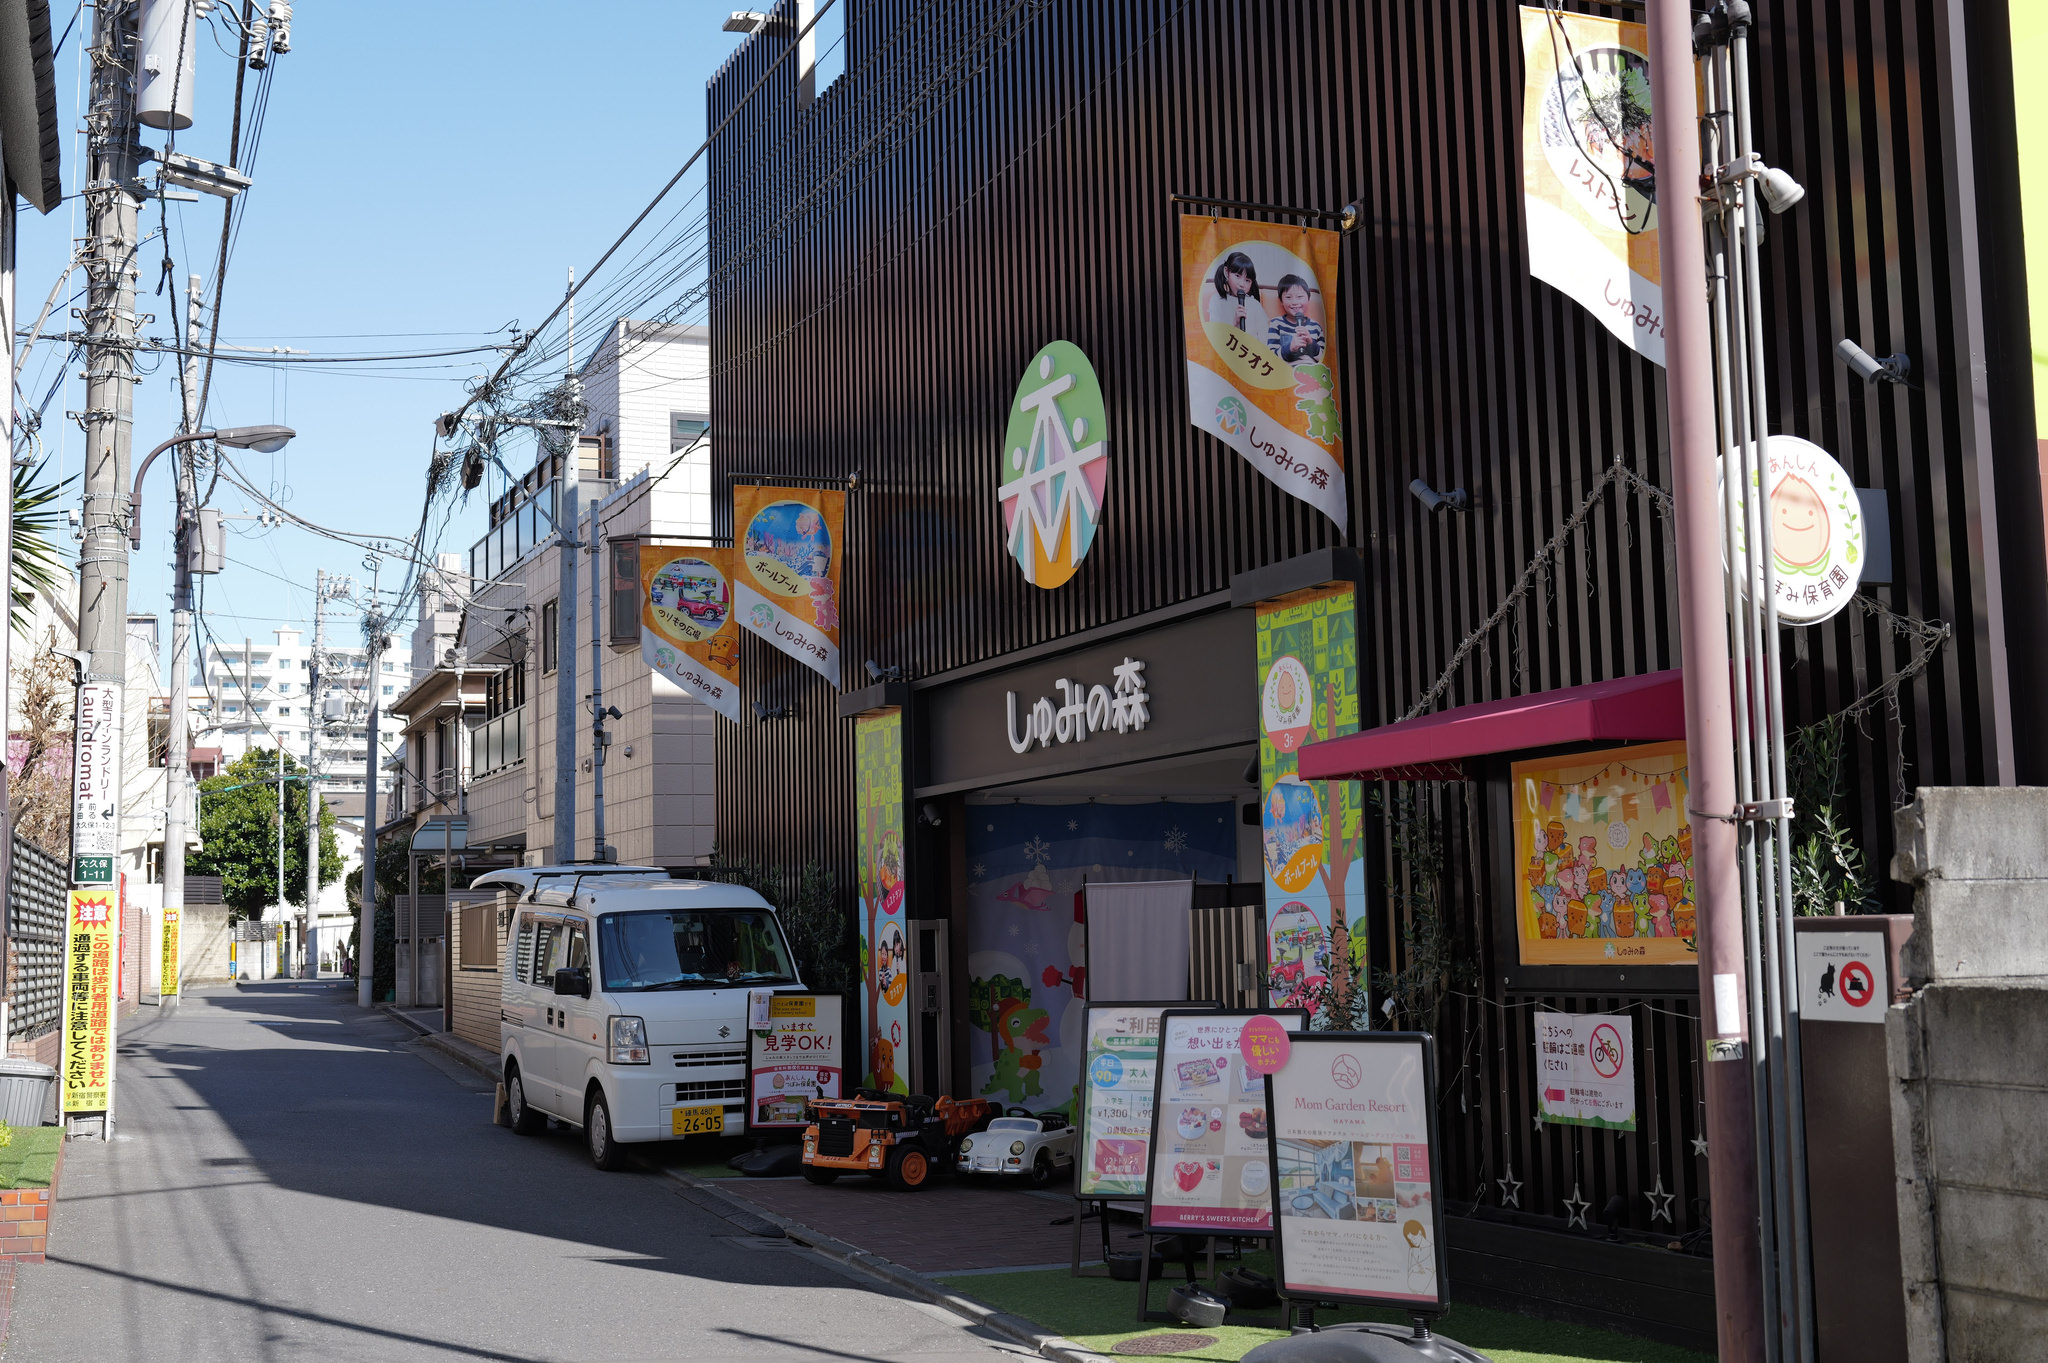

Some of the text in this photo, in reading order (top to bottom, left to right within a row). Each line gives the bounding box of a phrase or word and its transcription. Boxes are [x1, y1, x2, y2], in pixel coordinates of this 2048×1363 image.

[1226, 333, 1275, 378] カラオケ
[1250, 426, 1330, 490] しゅみの森
[1768, 454, 1819, 478] あんしん
[755, 561, 799, 595] ボールプール
[658, 608, 702, 641] のりもの広場
[774, 620, 829, 663] しゅみの森
[675, 662, 724, 701] しゅみの森
[1006, 656, 1151, 754] しゅみの森
[79, 686, 98, 801] Laundromat
[1283, 732, 1294, 749] 3F
[79, 859, 108, 868] 大久保
[1284, 854, 1318, 886] ボールプール
[82, 870, 105, 879] 1-11
[80, 904, 108, 922] 注意
[68, 933, 91, 1089] 通過する車両等に注意してください
[88, 933, 110, 1088] この道路は歩行者用道路ではありません
[781, 1022, 813, 1032] いますぐ
[1542, 1026, 1573, 1038] こちらへの
[763, 1034, 832, 1052] 見学OK!
[1248, 1034, 1280, 1045] ママにも
[1542, 1041, 1585, 1056] 駐輪はご遠慮
[1251, 1044, 1280, 1057] 優しい
[1129, 1068, 1148, 1078] 大人
[1543, 1059, 1568, 1071] ください
[1294, 1097, 1407, 1113] Mom Garden Resort
[683, 1115, 721, 1132] 26-05
